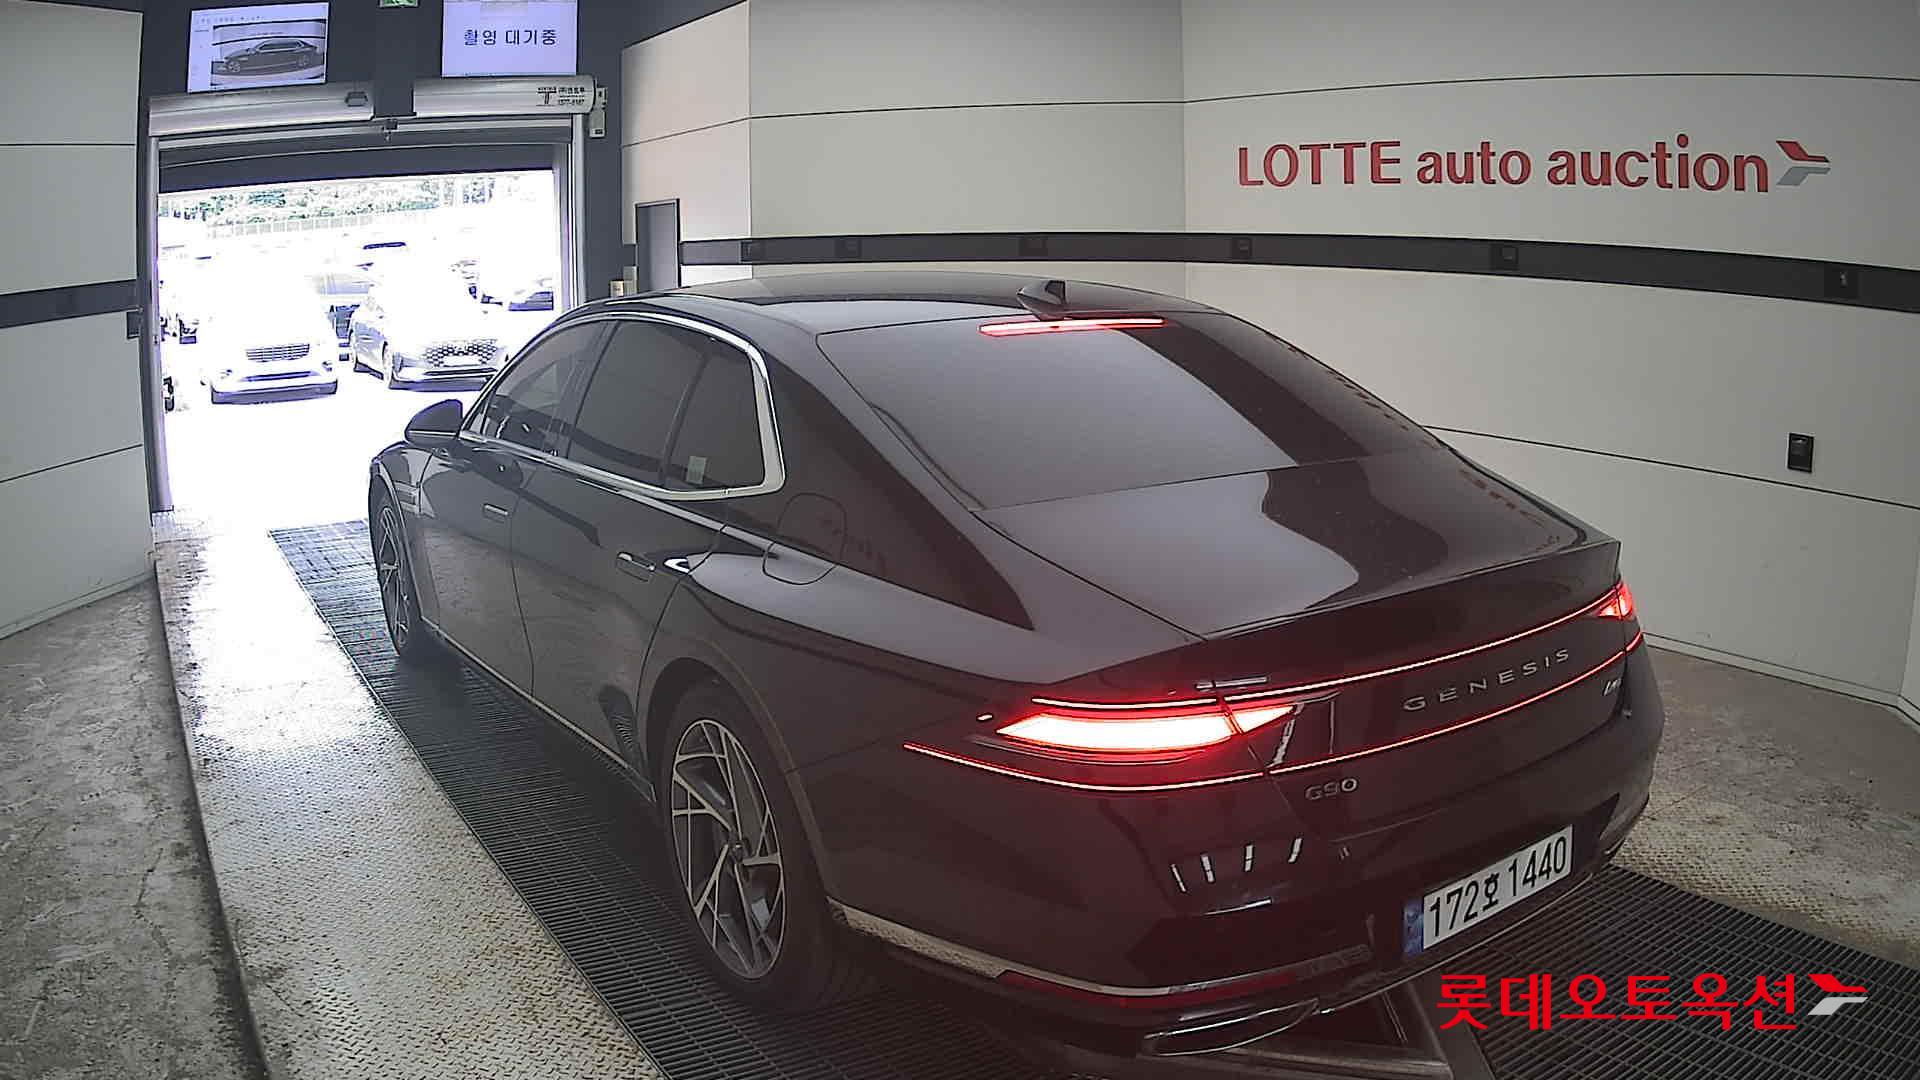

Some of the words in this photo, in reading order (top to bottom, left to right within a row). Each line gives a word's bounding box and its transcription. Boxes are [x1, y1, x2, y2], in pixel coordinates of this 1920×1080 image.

[505, 29, 557, 46] 대기중
[1238, 141, 1401, 187] LOTTE
[1416, 141, 1532, 185] auto
[1547, 133, 1769, 193] auction
[1403, 648, 1569, 711] GENESIS
[1304, 777, 1359, 801] G90
[1429, 873, 1499, 937] 172호
[1508, 836, 1567, 896] 1440
